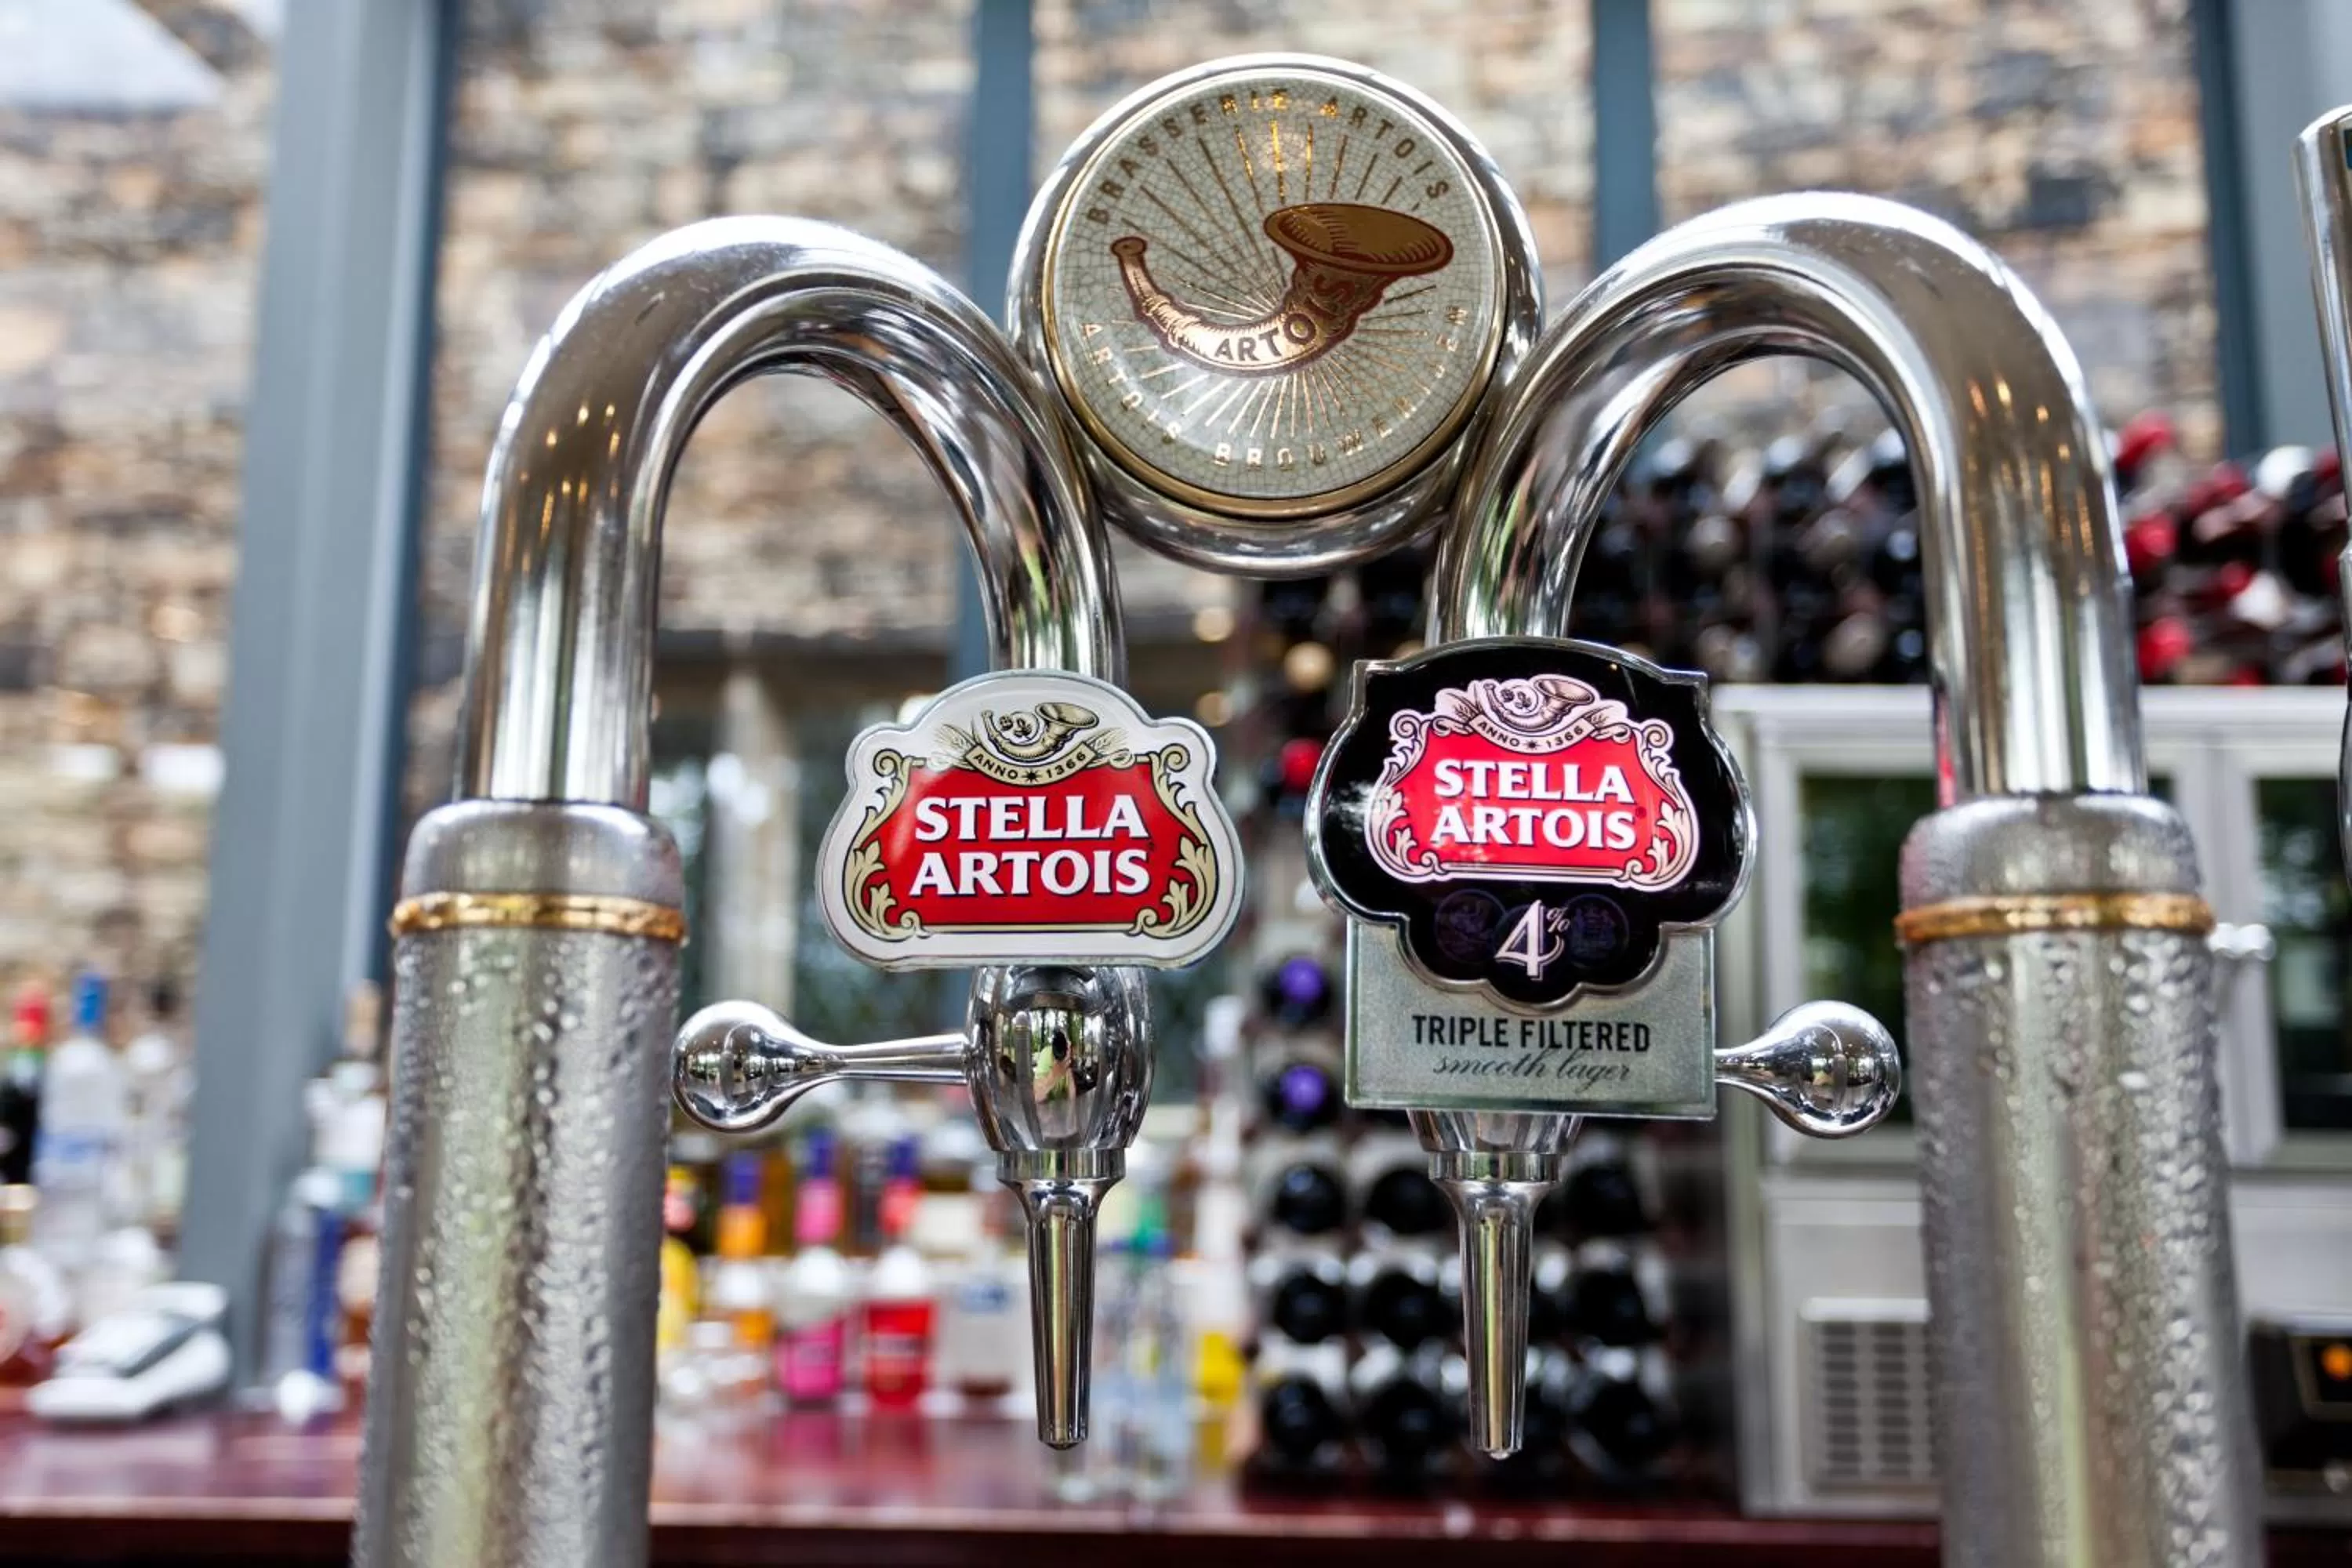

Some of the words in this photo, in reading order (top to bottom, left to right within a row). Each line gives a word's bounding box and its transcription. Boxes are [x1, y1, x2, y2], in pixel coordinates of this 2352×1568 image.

[1086, 88, 1289, 227] BRASSERIE
[1318, 95, 1450, 201] ARTOIS
[1080, 322, 1183, 445] ARTOIS
[1477, 723, 1521, 747] ANNO
[1545, 724, 1584, 750] 1366
[973, 752, 1020, 779] ANNO
[1045, 751, 1087, 779] 1366
[1434, 758, 1635, 804] STELLA
[914, 794, 1149, 841] STELLA
[1430, 806, 1636, 851] ARTOIS
[909, 848, 1151, 896] ARTOIS
[1494, 899, 1571, 982] 4%
[1412, 1015, 1510, 1049] TRIPLE
[1520, 1021, 1651, 1053] FILTERED
[1433, 1047, 1552, 1080] smooth
[1556, 1050, 1632, 1092] lager
